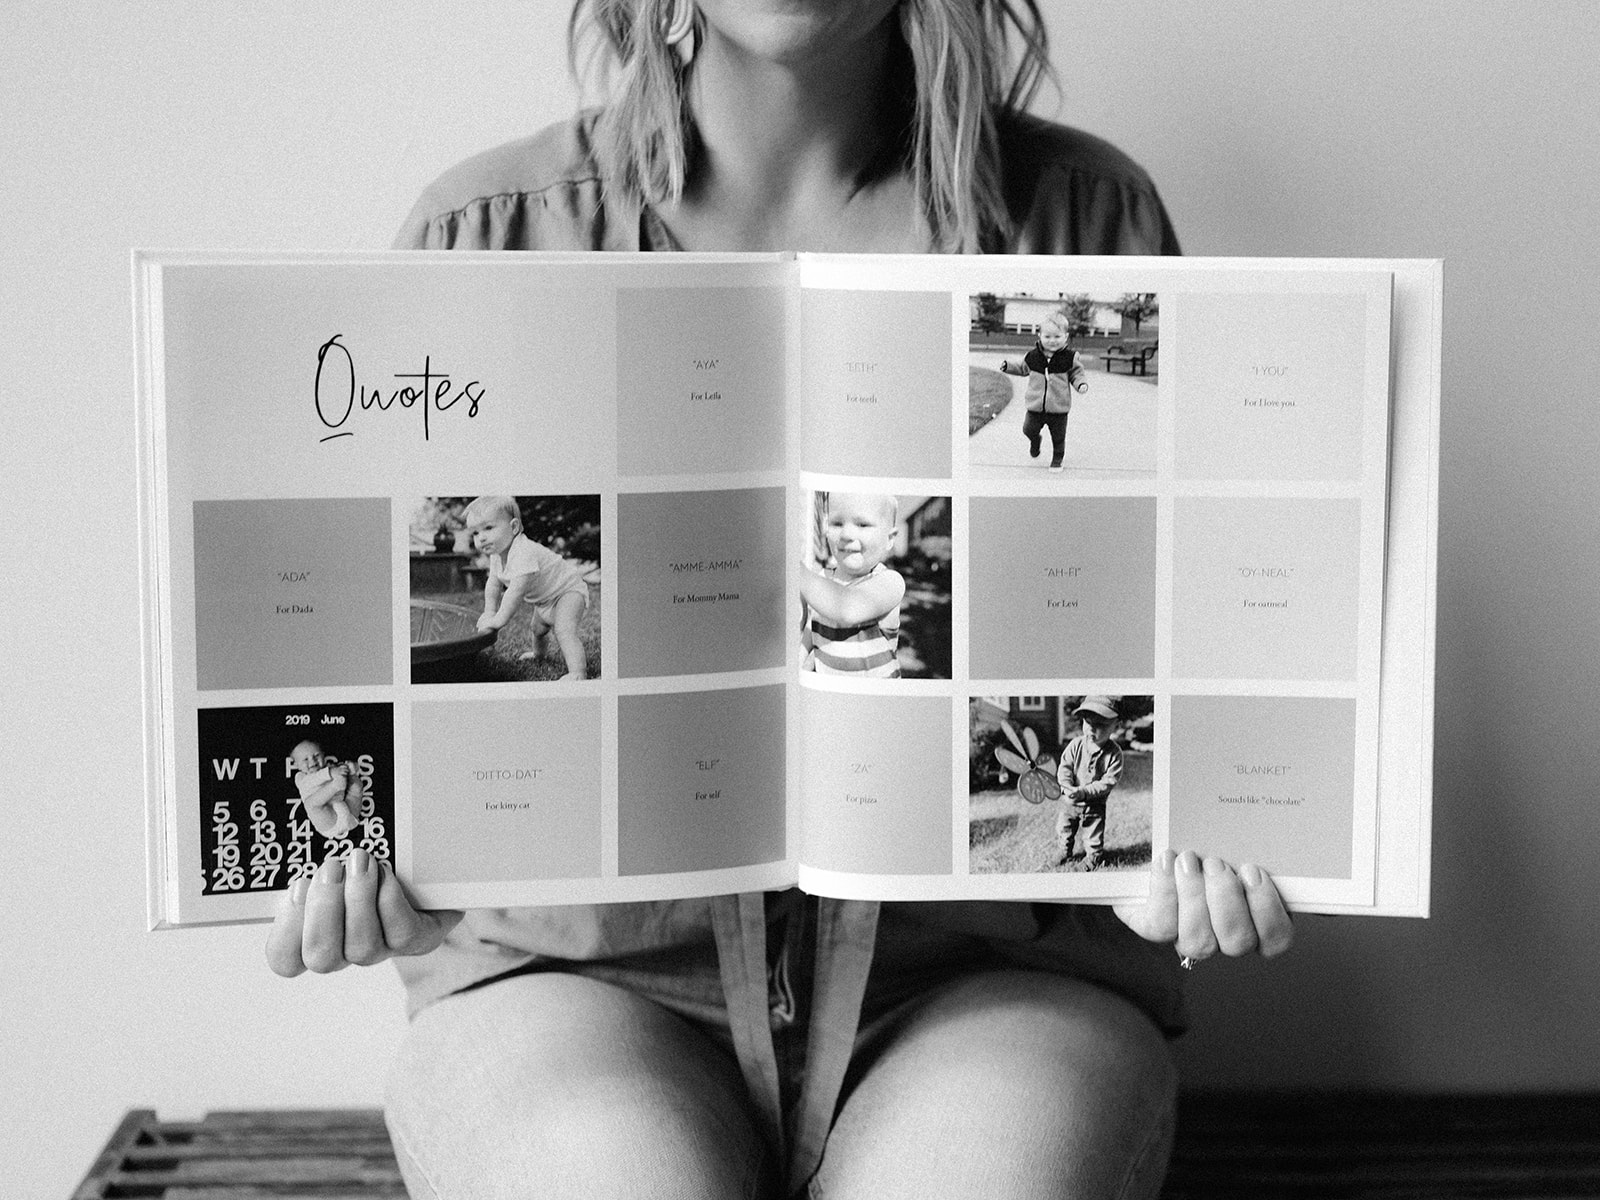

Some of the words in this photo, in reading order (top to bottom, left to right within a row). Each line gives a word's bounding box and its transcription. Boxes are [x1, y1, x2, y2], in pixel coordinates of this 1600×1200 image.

[692, 359, 719, 370] "AYA"
[314, 333, 486, 443] Quotes
[690, 392, 703, 401] For
[1244, 398, 1257, 407] For
[1263, 398, 1279, 407] love
[1279, 400, 1296, 409] you
[277, 571, 311, 582] "ADA"
[672, 594, 685, 604] For
[687, 594, 718, 604] Mommy
[718, 592, 740, 601] Mama
[1047, 600, 1061, 608] For
[1062, 599, 1079, 608] Levi
[1243, 599, 1256, 608] For
[1257, 599, 1288, 608] oatmeal
[276, 605, 290, 614] For
[291, 604, 314, 614] Dada
[285, 714, 310, 726] 2019
[320, 714, 345, 725] June
[212, 757, 240, 781] W
[249, 757, 268, 779] T
[695, 759, 720, 771] "ELF"
[1233, 765, 1292, 775] "BLANKET"
[695, 792, 708, 801] For
[846, 794, 859, 802] For
[1218, 795, 1246, 804] Sounds
[1246, 795, 1260, 804] like
[213, 801, 231, 824] 5
[250, 799, 268, 822] 6
[286, 798, 302, 820] 7
[485, 802, 499, 810] For
[212, 822, 240, 846] 12
[250, 820, 277, 843] 13
[286, 819, 314, 842] 14
[359, 816, 386, 840] 16
[212, 845, 241, 869] 19
[250, 841, 284, 866] 20
[287, 840, 312, 864] 21
[212, 866, 246, 892] 26
[250, 864, 281, 889] 27
